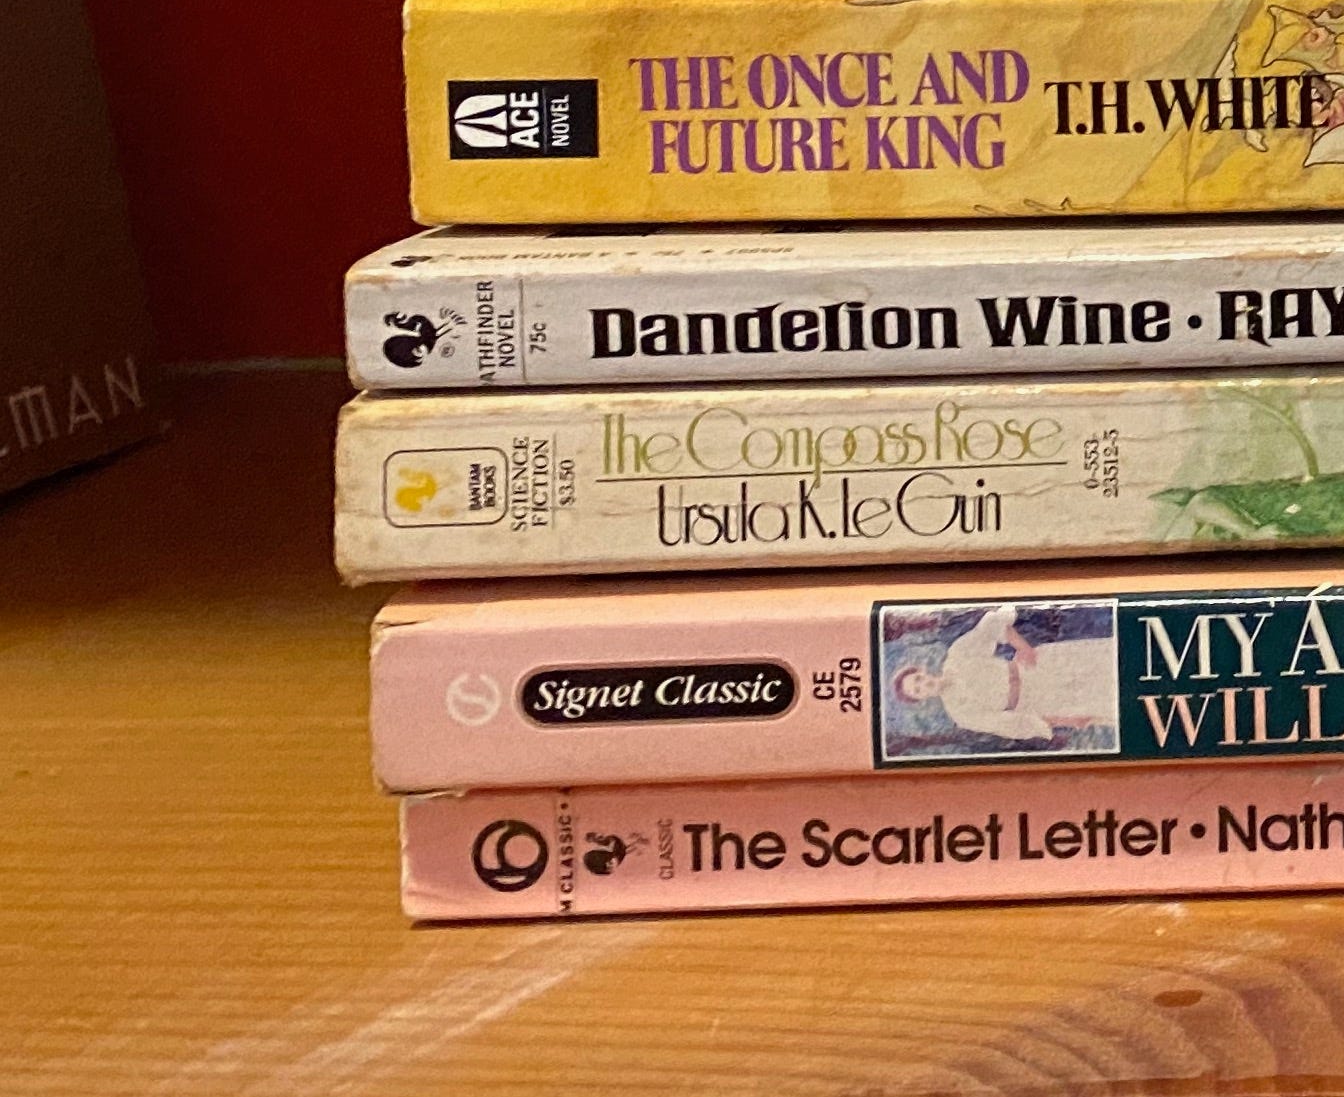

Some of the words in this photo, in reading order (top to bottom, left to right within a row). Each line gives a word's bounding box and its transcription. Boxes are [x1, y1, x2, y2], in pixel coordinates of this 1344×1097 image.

[629, 55, 736, 111] THE
[748, 51, 893, 109] ONCE
[911, 48, 1032, 107] AND
[509, 91, 540, 149] ACE
[551, 94, 570, 147] NOVEL
[650, 116, 850, 175] FUTURE
[866, 111, 1006, 171] KING
[499, 309, 515, 368] NOVEL
[589, 301, 961, 360] Dandelion
[978, 294, 1171, 347] Wine
[602, 414, 681, 474] The
[686, 407, 926, 489] Compass
[935, 401, 1065, 461] Rose
[468, 463, 482, 511] BANTAM
[483, 465, 496, 508] BOOKS
[512, 436, 529, 532] SCIENCE
[532, 439, 549, 527] FICTION
[559, 459, 576, 506] $3.50
[657, 482, 788, 547] Ursula
[799, 479, 837, 540] K.
[897, 472, 1002, 535] Guin
[1139, 613, 1275, 680] MY
[534, 679, 644, 719] Signet
[654, 673, 782, 706] Classic
[813, 671, 835, 700] CE
[840, 658, 862, 712] 2579
[559, 814, 574, 893] CLASSIC
[657, 819, 675, 880] CLASSIC
[684, 824, 787, 872] The
[803, 812, 1001, 867] Scarlet
[1019, 809, 1176, 861] Letter
